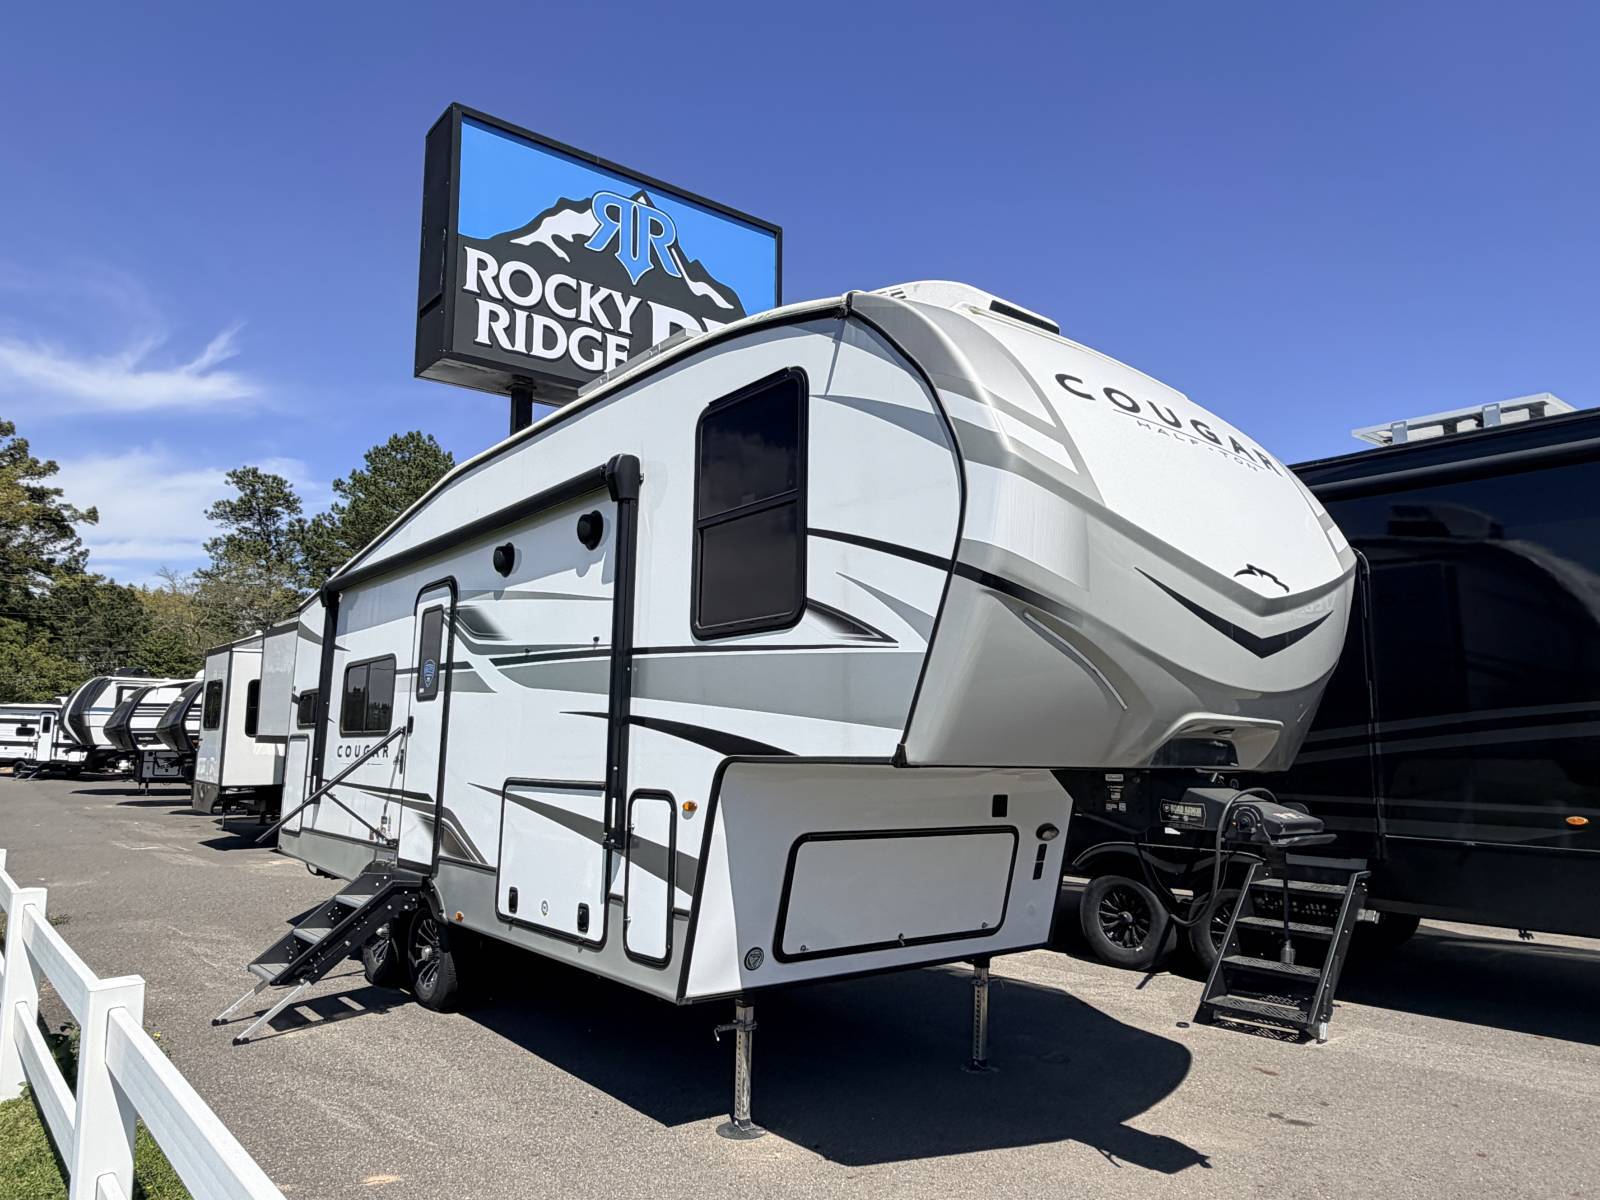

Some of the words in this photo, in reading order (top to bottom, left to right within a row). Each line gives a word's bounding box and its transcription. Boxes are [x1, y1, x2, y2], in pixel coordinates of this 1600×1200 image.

[463, 246, 642, 335] ROCKY
[474, 299, 631, 373] RIDGE
[1055, 373, 1283, 477] COUGAR
